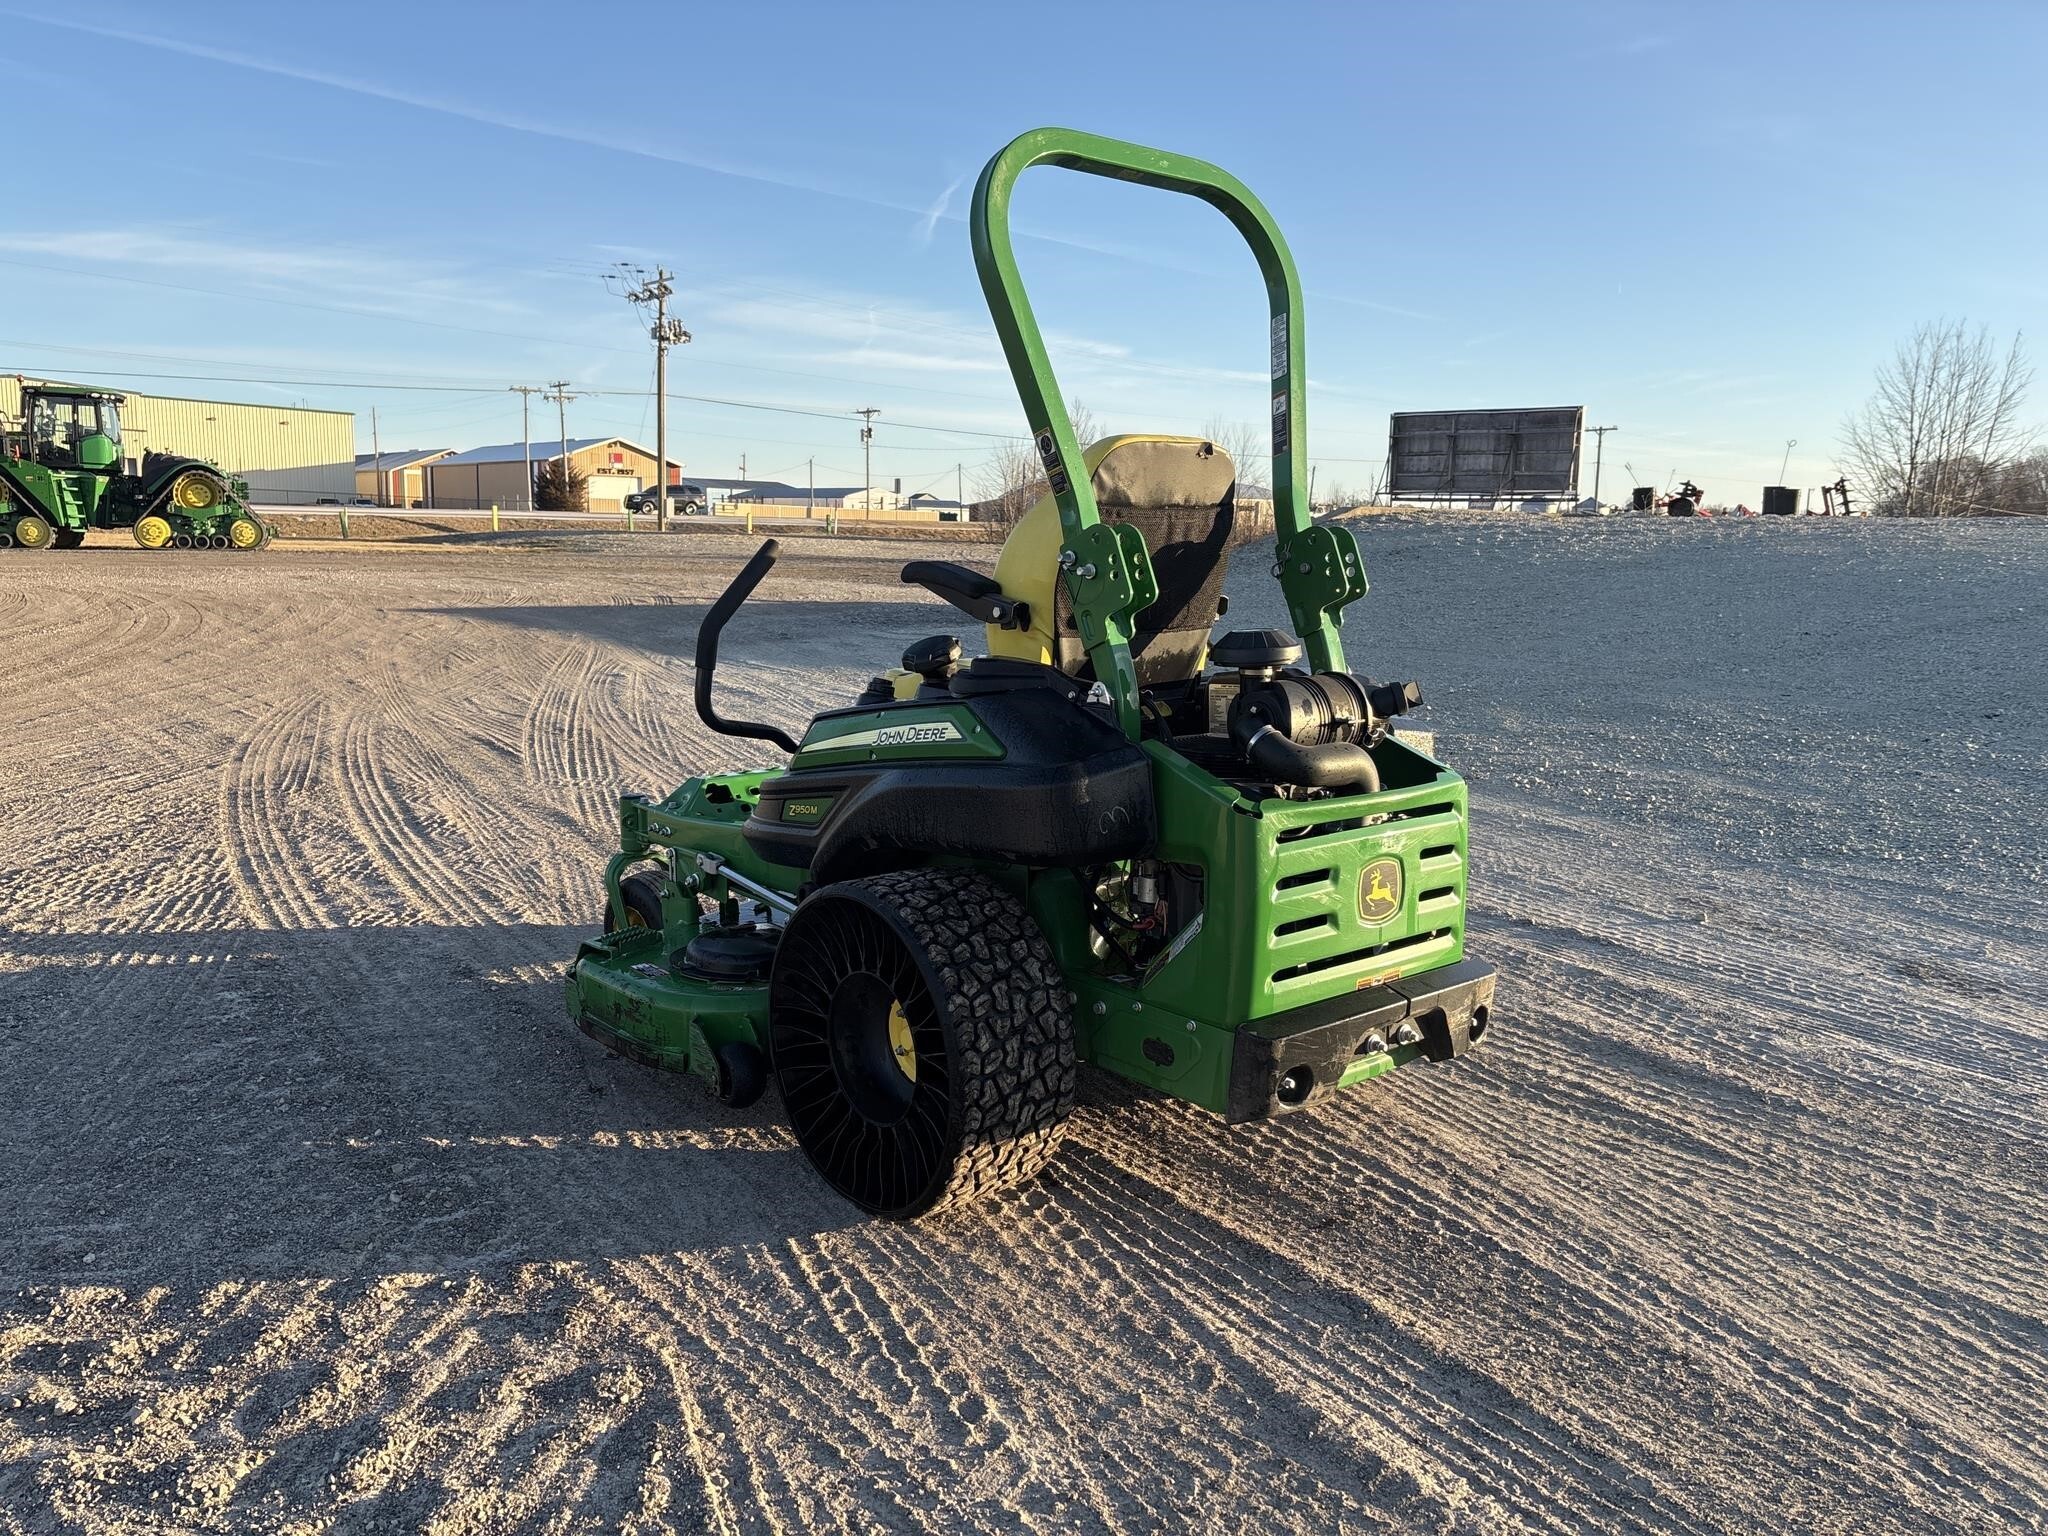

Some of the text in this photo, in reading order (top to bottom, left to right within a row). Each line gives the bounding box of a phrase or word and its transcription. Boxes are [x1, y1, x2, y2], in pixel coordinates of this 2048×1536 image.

[597, 467, 635, 476] EST. 1957
[872, 726, 949, 745] JOHN DEERE
[789, 804, 818, 816] Z950M
